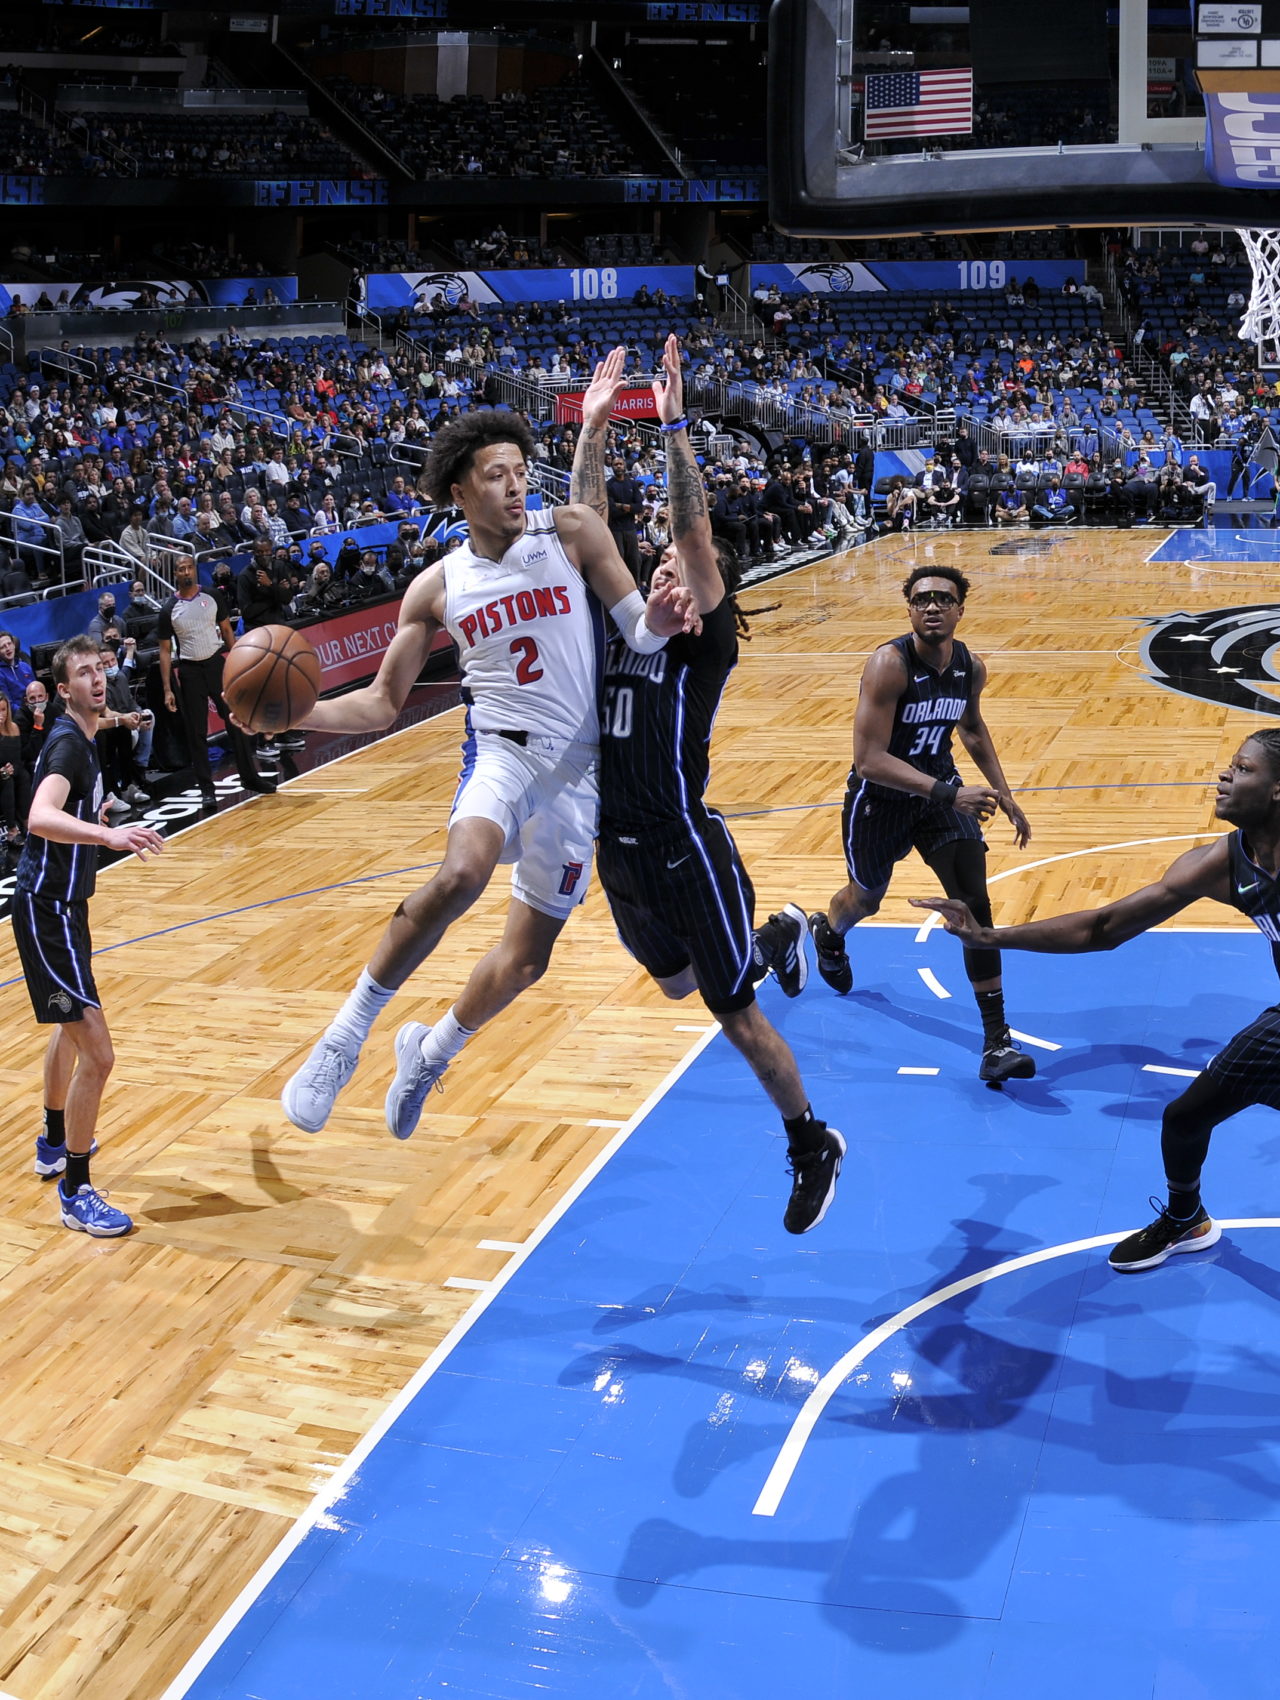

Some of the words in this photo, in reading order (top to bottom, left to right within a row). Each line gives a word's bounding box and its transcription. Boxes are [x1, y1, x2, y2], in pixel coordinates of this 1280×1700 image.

[570, 268, 617, 300] 108
[958, 261, 1006, 290] 109
[522, 549, 547, 566] UWM
[459, 586, 571, 648] PISTONS
[343, 627, 383, 658] NEXT
[509, 636, 543, 686] 2
[908, 726, 946, 756] 34
